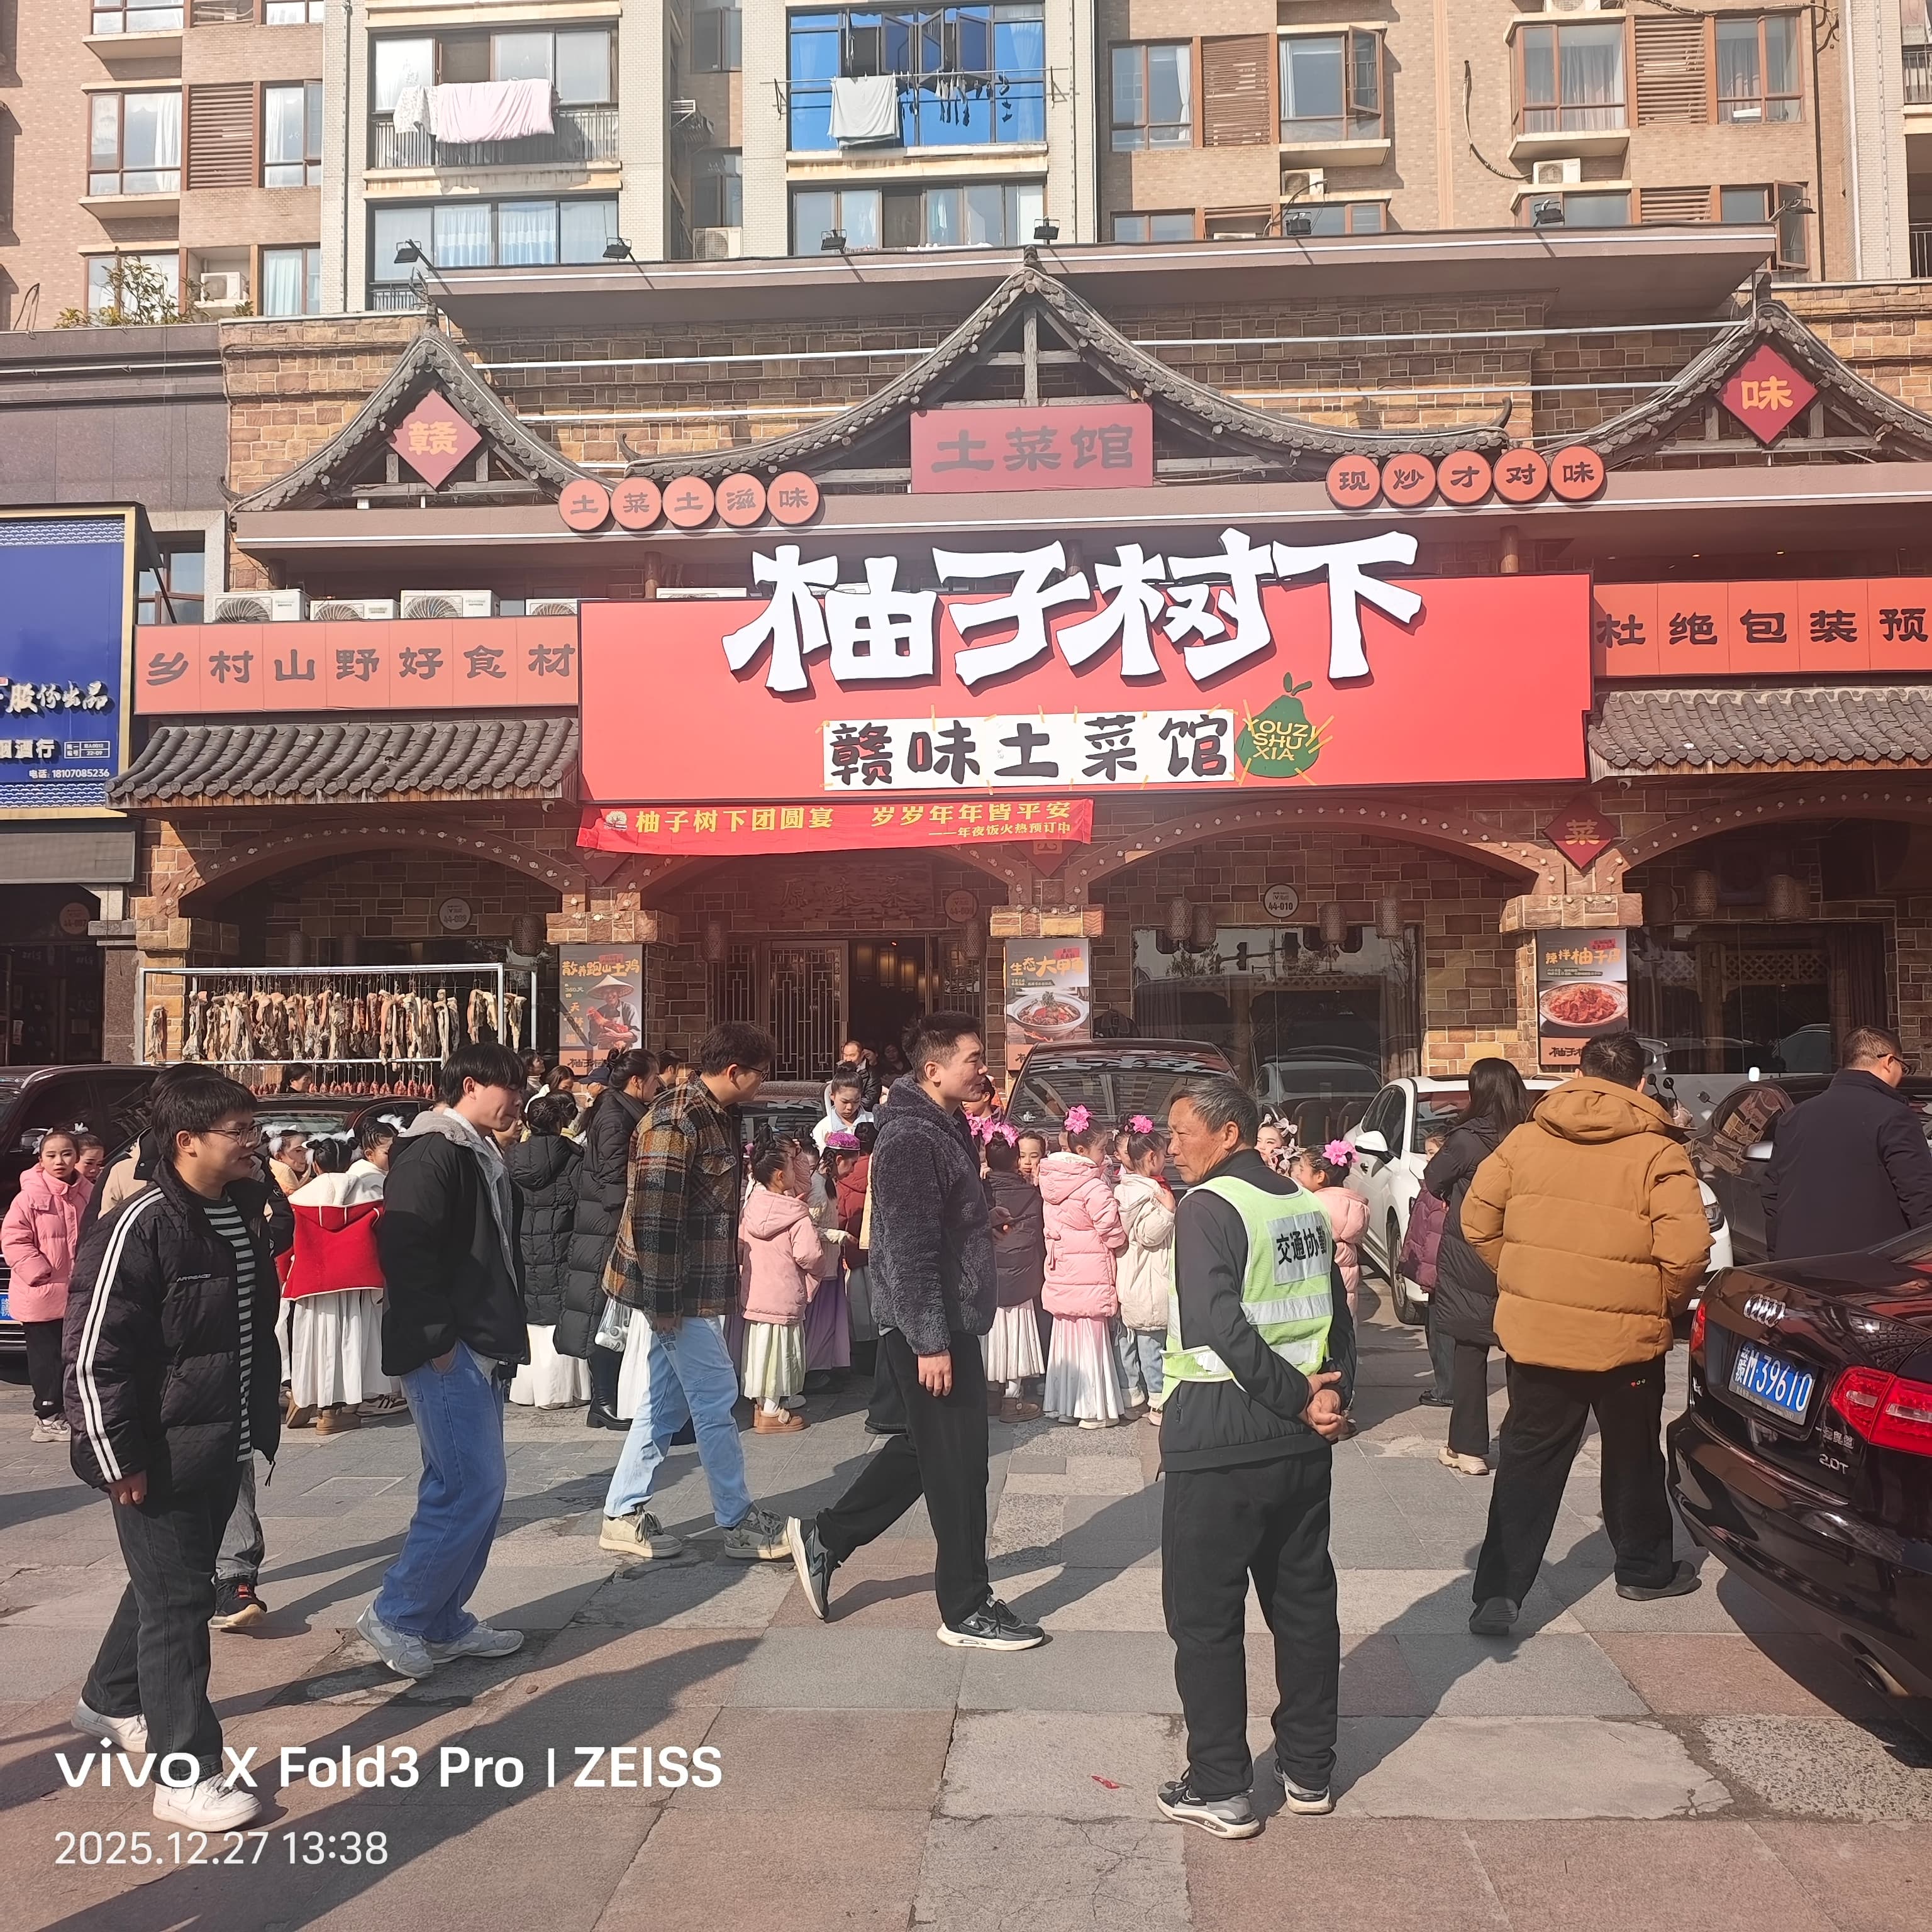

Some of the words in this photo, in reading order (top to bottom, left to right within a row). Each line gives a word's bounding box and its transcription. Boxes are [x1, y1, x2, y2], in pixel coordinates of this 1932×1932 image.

[1740, 374, 1794, 413] 味
[408, 420, 458, 457] 赣
[930, 423, 1134, 474] 土菜馆
[1338, 461, 1595, 491] 现炒才对味
[570, 487, 809, 515] 土菜土滋味
[722, 528, 1423, 692] 柚子树下
[1596, 608, 1929, 648] 杜绝包装预
[146, 643, 575, 686] 乡村山野好食材
[1242, 718, 1318, 739] YOUZI
[1253, 733, 1302, 750] SHU
[828, 714, 1229, 786] 赣味土菜馆
[1253, 746, 1295, 761] XIA
[635, 806, 834, 834] 柚子树下团圆宴
[870, 801, 1071, 827] 岁岁年年皆平安
[1564, 819, 1600, 845] 菜
[1268, 902, 1293, 911] 44-010
